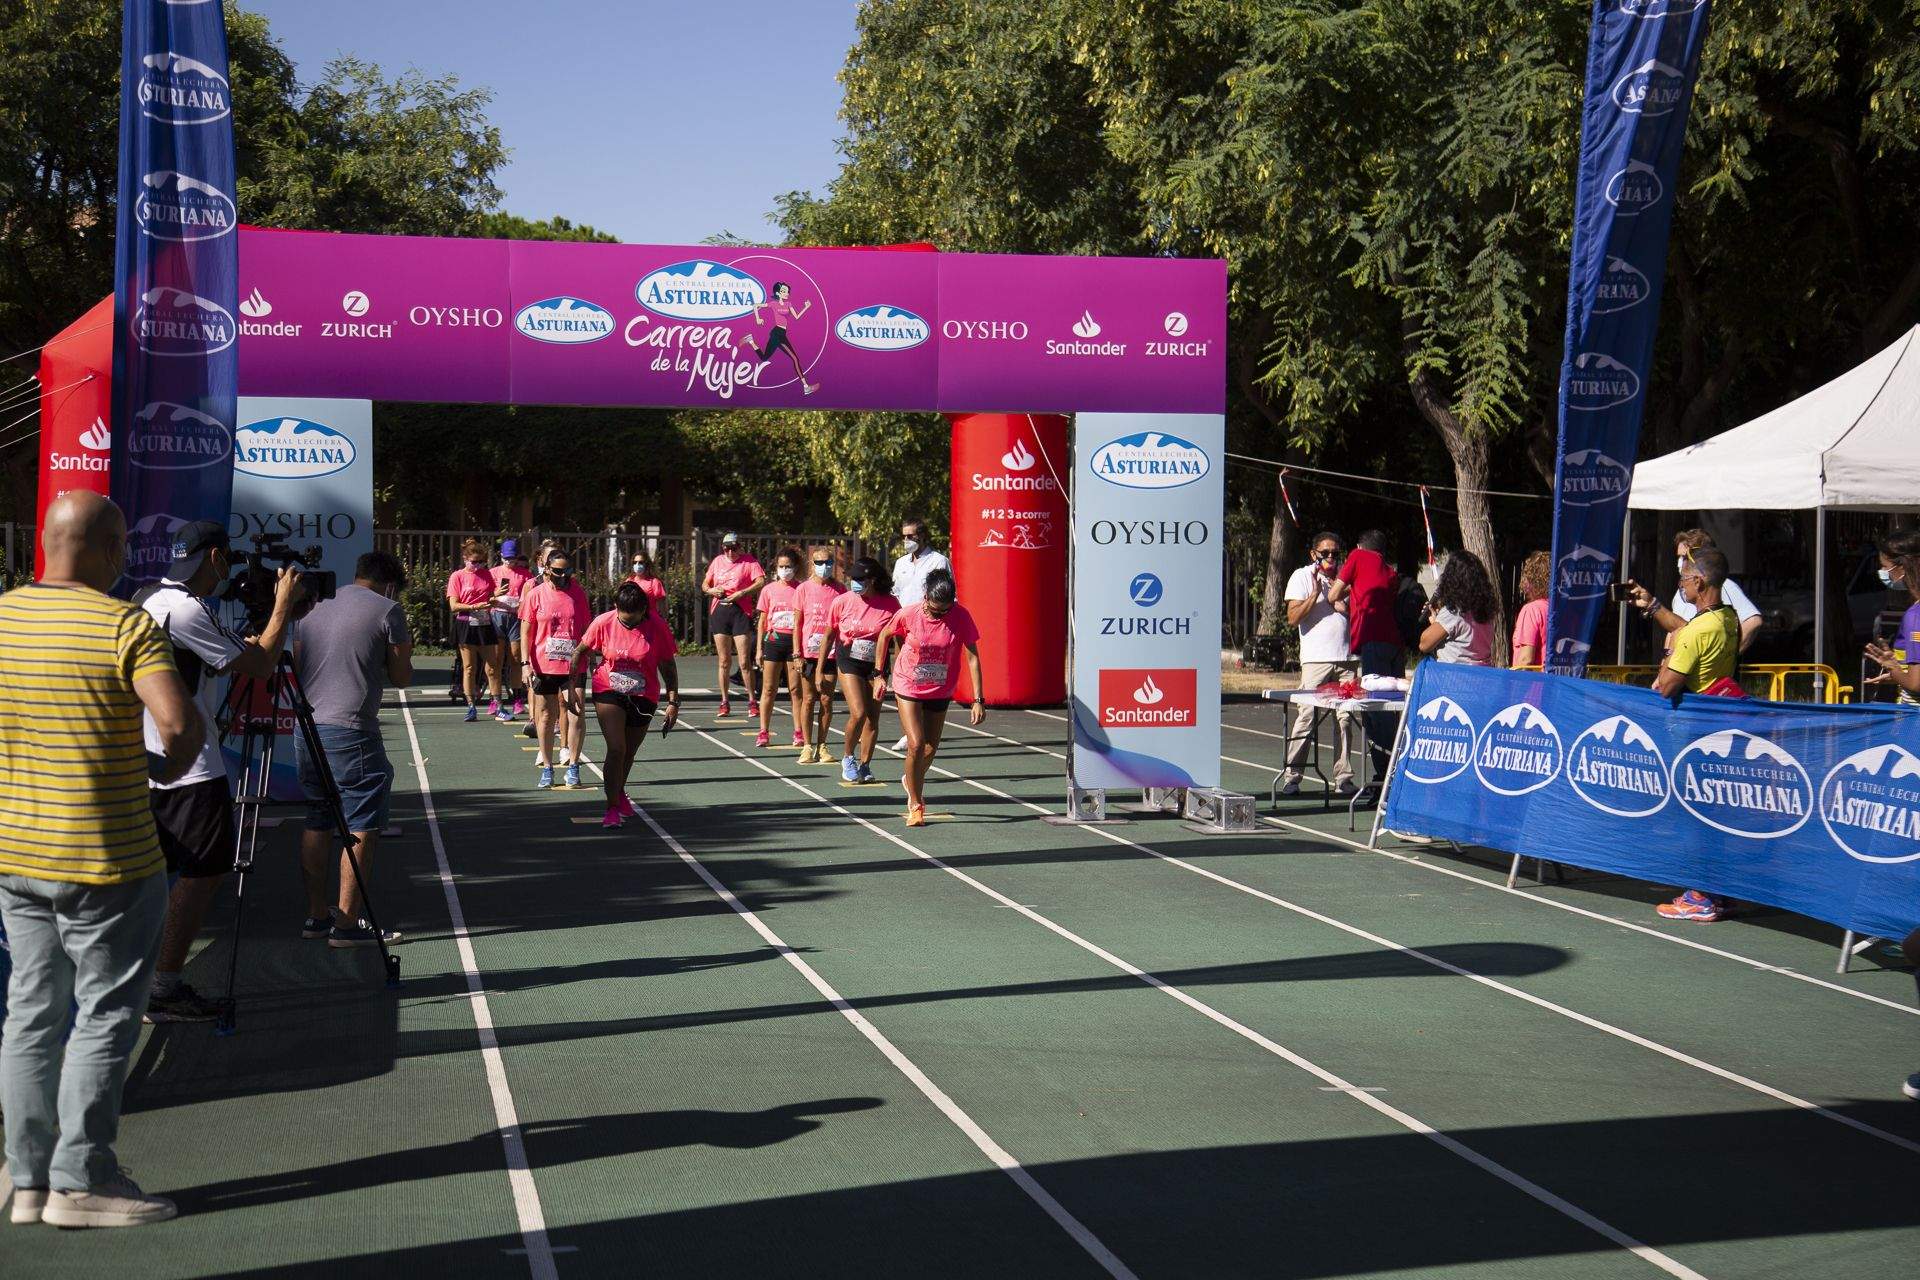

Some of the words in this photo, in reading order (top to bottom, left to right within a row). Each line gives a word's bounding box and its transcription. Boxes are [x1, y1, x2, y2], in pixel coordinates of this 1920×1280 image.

[646, 280, 756, 307] ASTURIANA
[409, 306, 503, 328] OYSHO
[523, 313, 608, 332] ASTURIANA
[321, 323, 392, 338] ZURICH
[624, 314, 733, 349] Carrera
[842, 320, 923, 340] ASTURIANA
[942, 320, 1029, 340] OYSHO
[1046, 339, 1127, 356] Santander
[1145, 341, 1207, 356] ZURICH
[650, 349, 671, 371] de
[675, 349, 690, 372] la
[685, 346, 772, 399] Mujer
[1100, 452, 1202, 475] ASTURIANA
[972, 473, 1057, 491] Santander
[227, 512, 356, 540] OYSHO
[1091, 520, 1209, 546] OYSHO
[1100, 617, 1190, 635] ZURICH
[1105, 706, 1191, 724] Santander
[1478, 733, 1553, 777] ASTURIANA
[1591, 745, 1624, 761] CENTRAL
[1624, 751, 1658, 767] LECHERA
[1573, 746, 1665, 798] ASTURIANA
[1701, 762, 1748, 777] CENTRAL
[1750, 767, 1799, 783] LECHERA
[1683, 762, 1804, 817] ASTURIANA
[1850, 780, 1886, 796] CENTRAL
